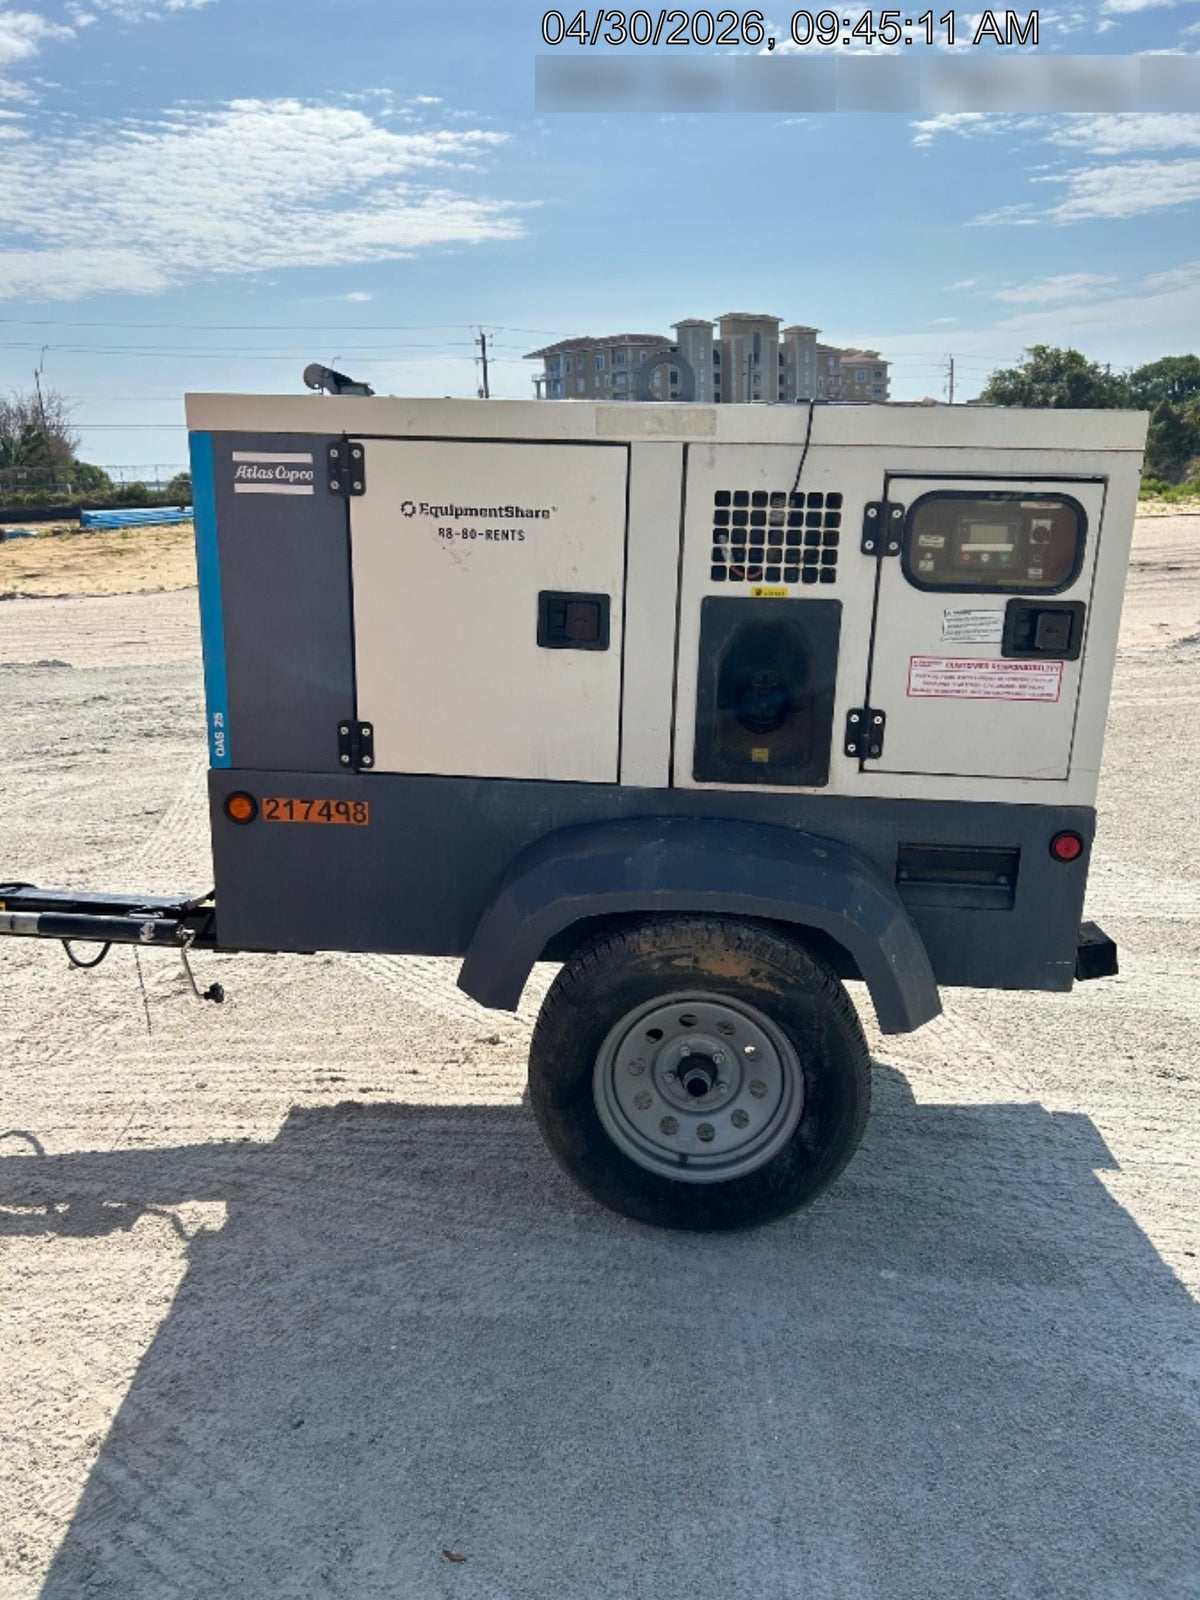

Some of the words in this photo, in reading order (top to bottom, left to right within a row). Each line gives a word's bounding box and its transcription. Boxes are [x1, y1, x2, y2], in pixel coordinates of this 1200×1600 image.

[234, 465, 274, 479] Atlas
[275, 465, 314, 482] Copco
[213, 712, 224, 728] 25
[265, 799, 367, 823] 217498
